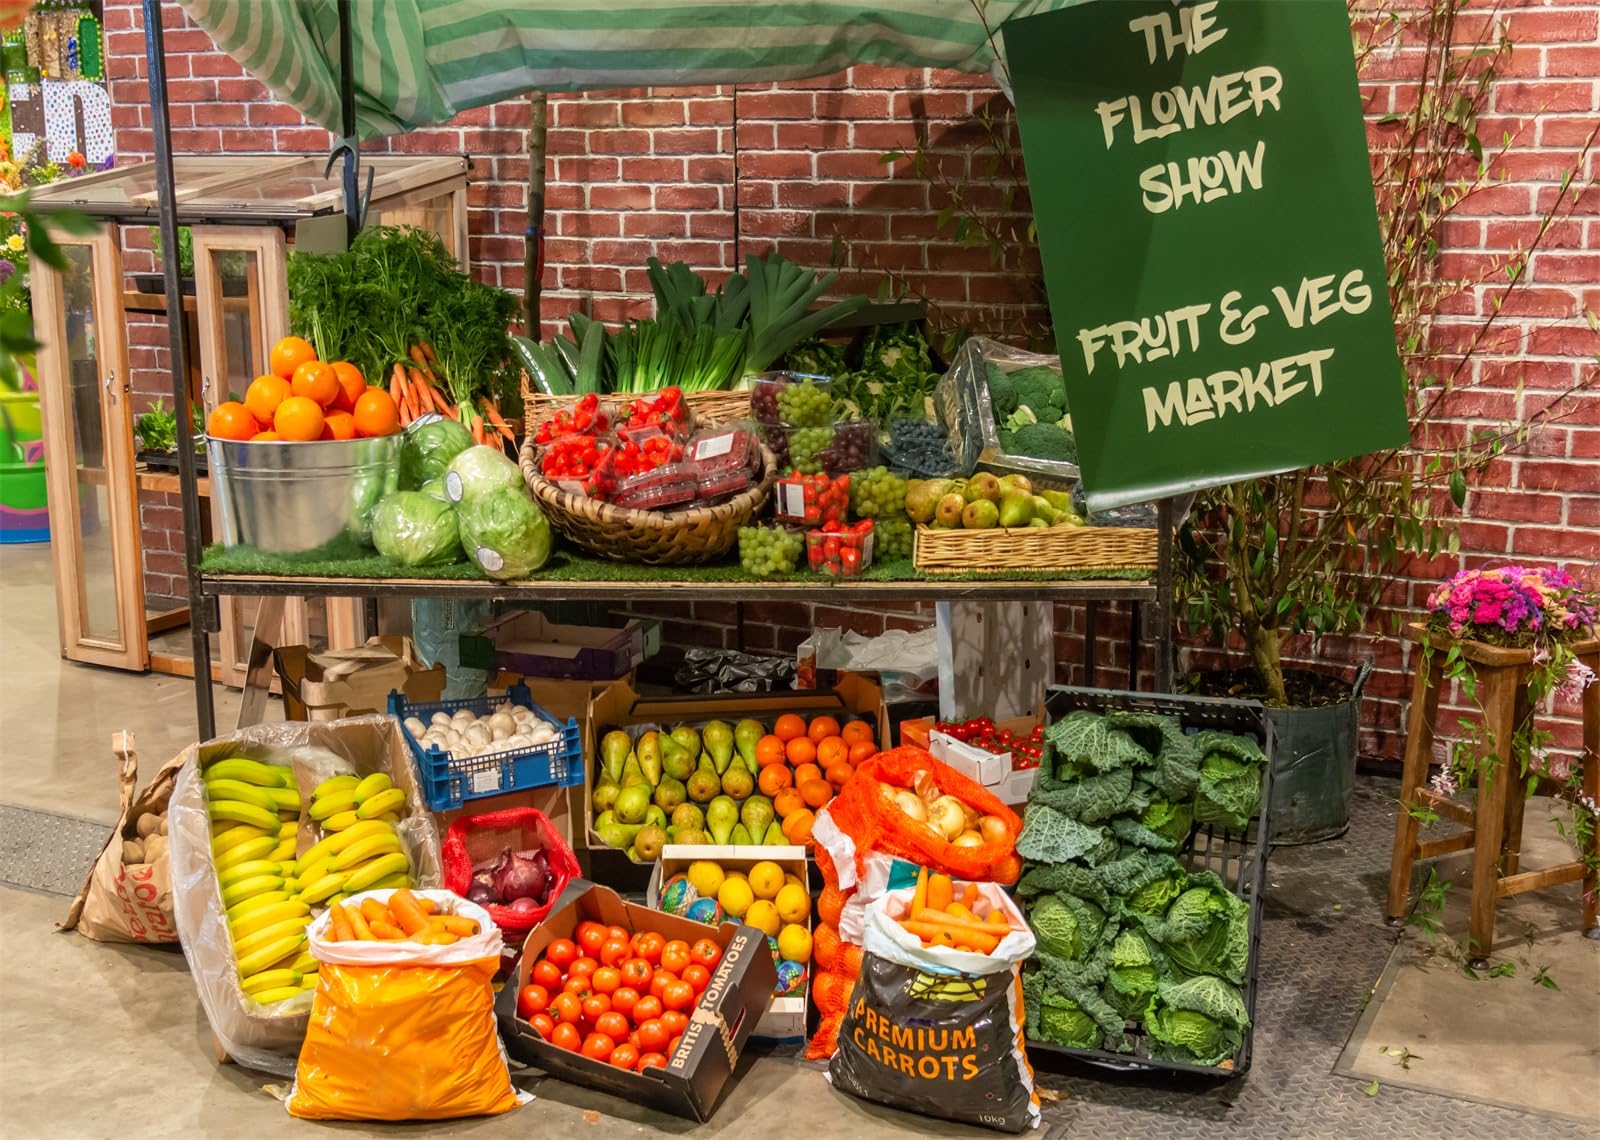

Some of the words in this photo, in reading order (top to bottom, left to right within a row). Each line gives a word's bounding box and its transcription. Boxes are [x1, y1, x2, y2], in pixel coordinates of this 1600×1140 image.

[1129, 0, 1228, 64] THE
[1095, 66, 1283, 149] FLOWER
[1139, 141, 1265, 213] SHOW
[1076, 303, 1211, 375] FRUIT
[1219, 291, 1269, 345] &
[1272, 269, 1372, 328] VEG
[1142, 348, 1335, 432] MARKET
[671, 1010, 706, 1069] BRITIS
[701, 934, 748, 1009] TOMATOES
[855, 997, 977, 1051] PREMIUM
[853, 1027, 979, 1081] CARROTS
[979, 1114, 1006, 1126] 10kg
